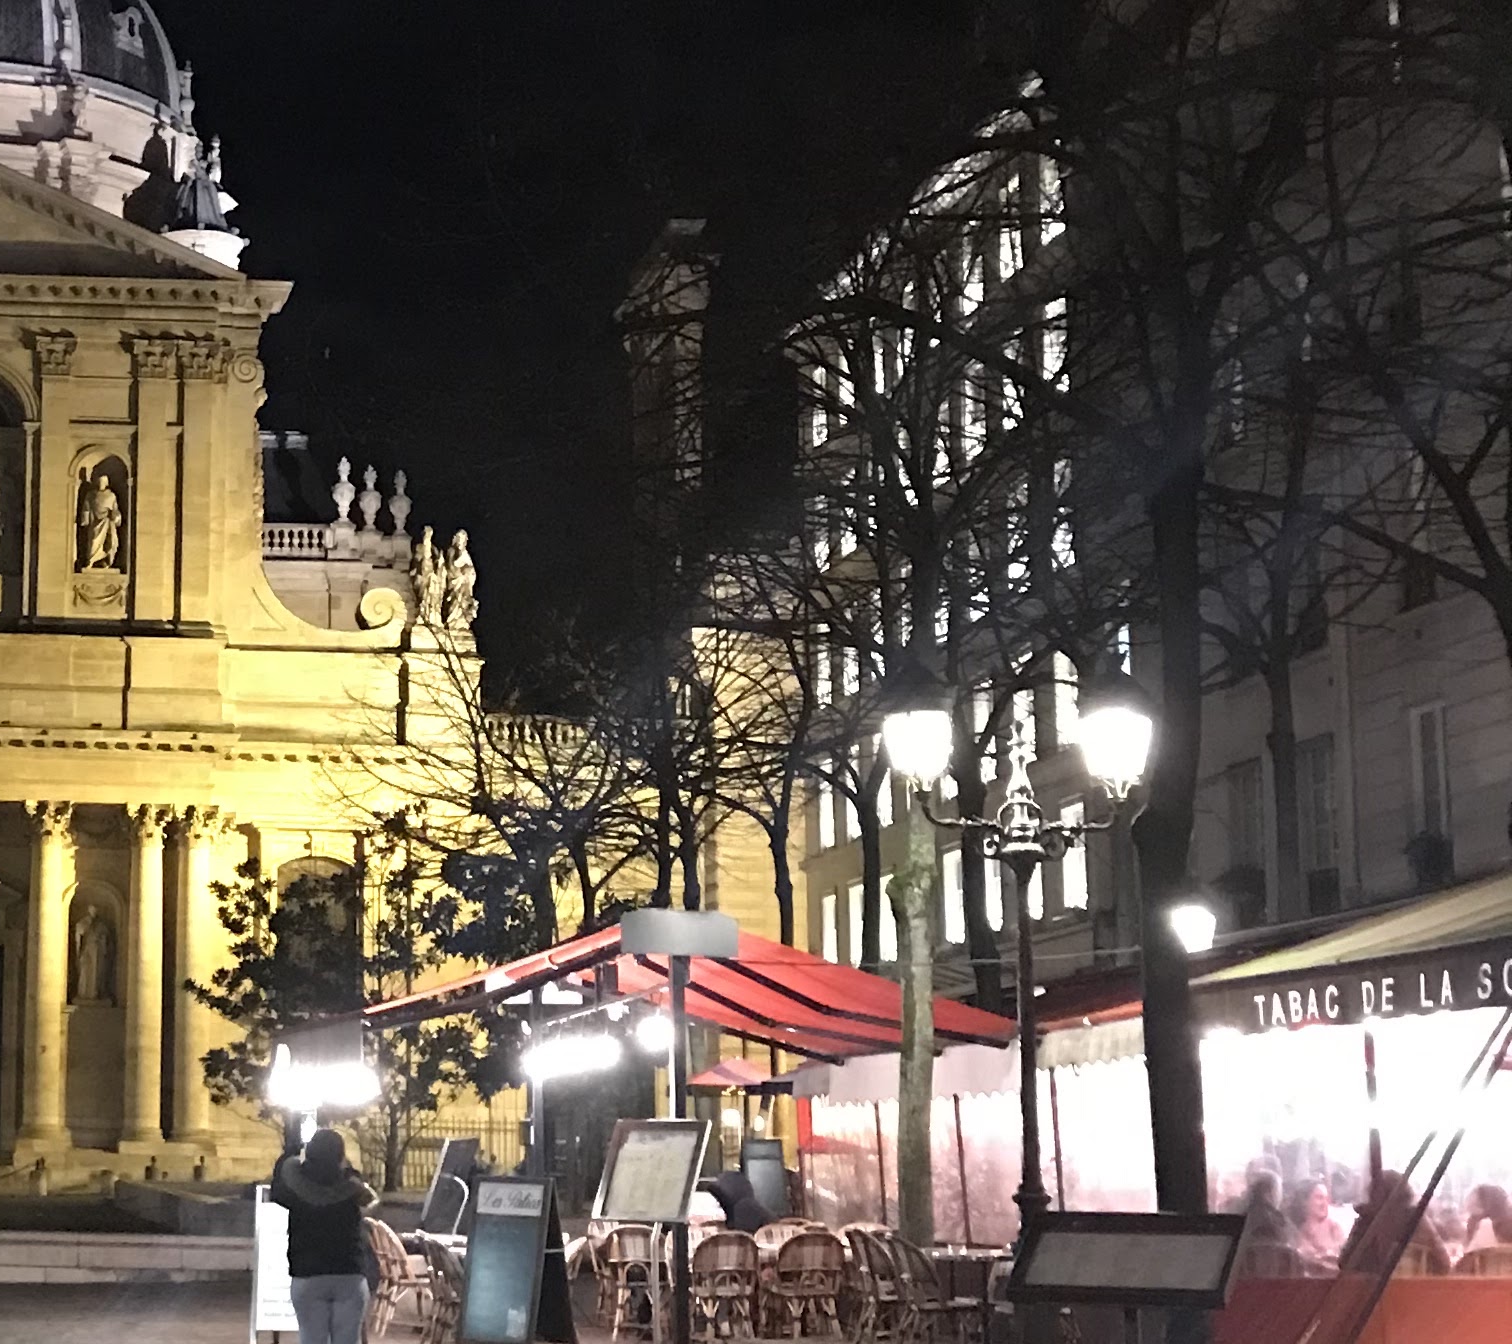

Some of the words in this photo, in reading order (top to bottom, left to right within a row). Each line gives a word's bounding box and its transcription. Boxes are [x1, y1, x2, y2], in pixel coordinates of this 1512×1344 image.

[1253, 984, 1339, 1026] TABAC
[1361, 977, 1394, 1014] DE
[1419, 969, 1453, 1008] LA
